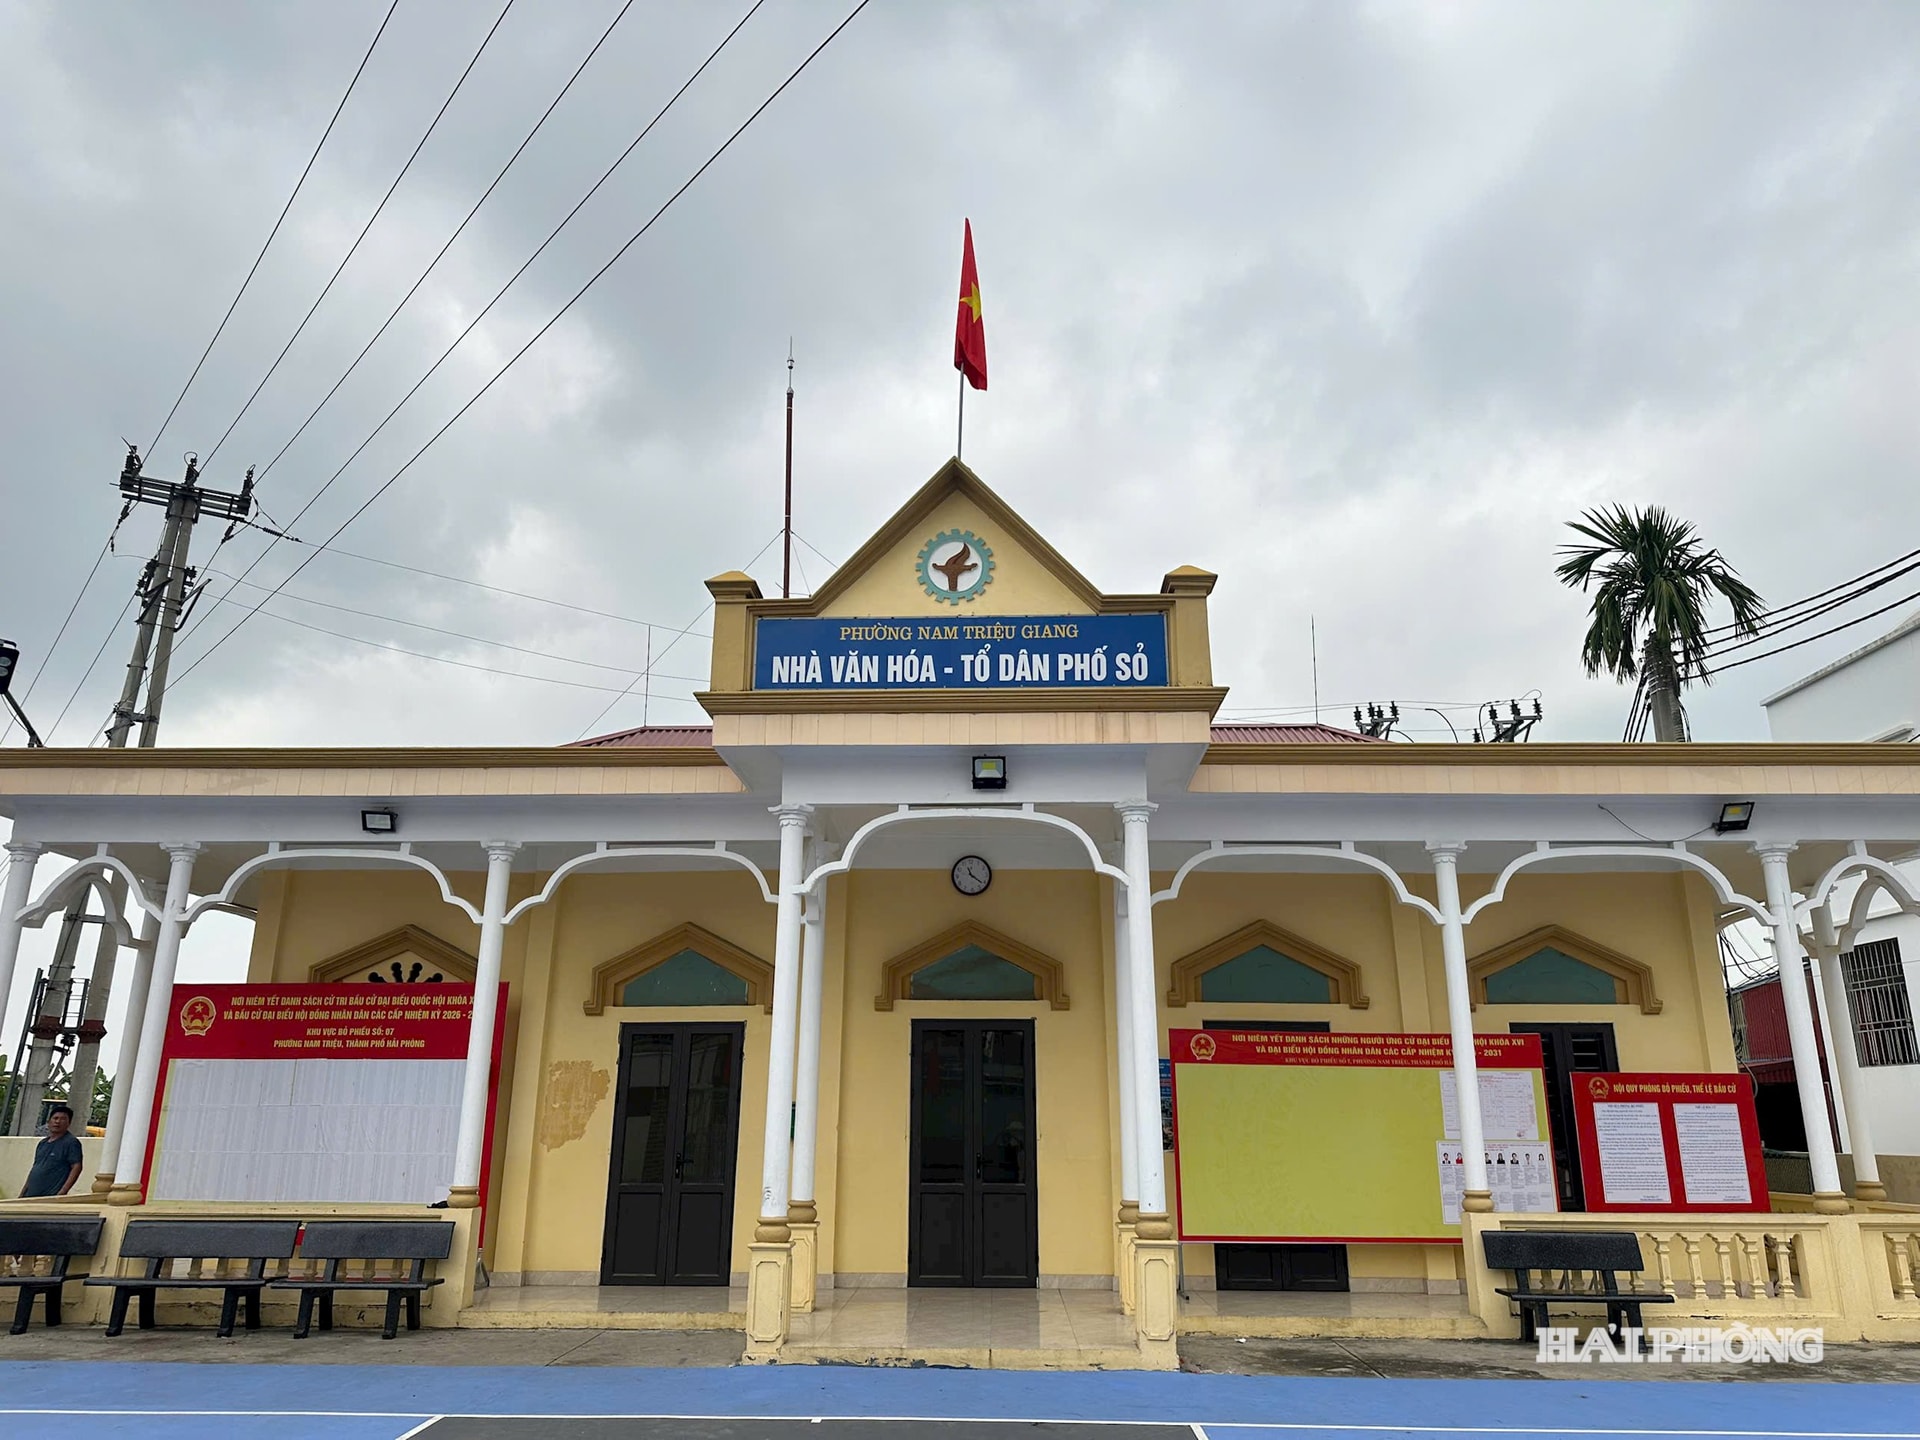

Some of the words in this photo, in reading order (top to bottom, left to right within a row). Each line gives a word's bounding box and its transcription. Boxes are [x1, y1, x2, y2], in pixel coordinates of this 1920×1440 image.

[839, 622, 912, 641] PHƯỜNG
[917, 626, 959, 640] NAM
[963, 623, 1016, 641] TRIỆU
[1021, 624, 1079, 639] GIANG
[772, 650, 823, 683] NHÀ
[830, 649, 880, 683] VĂN
[887, 648, 936, 683] HÓA
[944, 666, 953, 674] -
[960, 643, 992, 682] TỔ
[998, 648, 1050, 682] DÂN
[1058, 645, 1109, 682] PHỐ
[1115, 642, 1149, 681] SỎ
[1484, 1049, 1502, 1057] 2031
